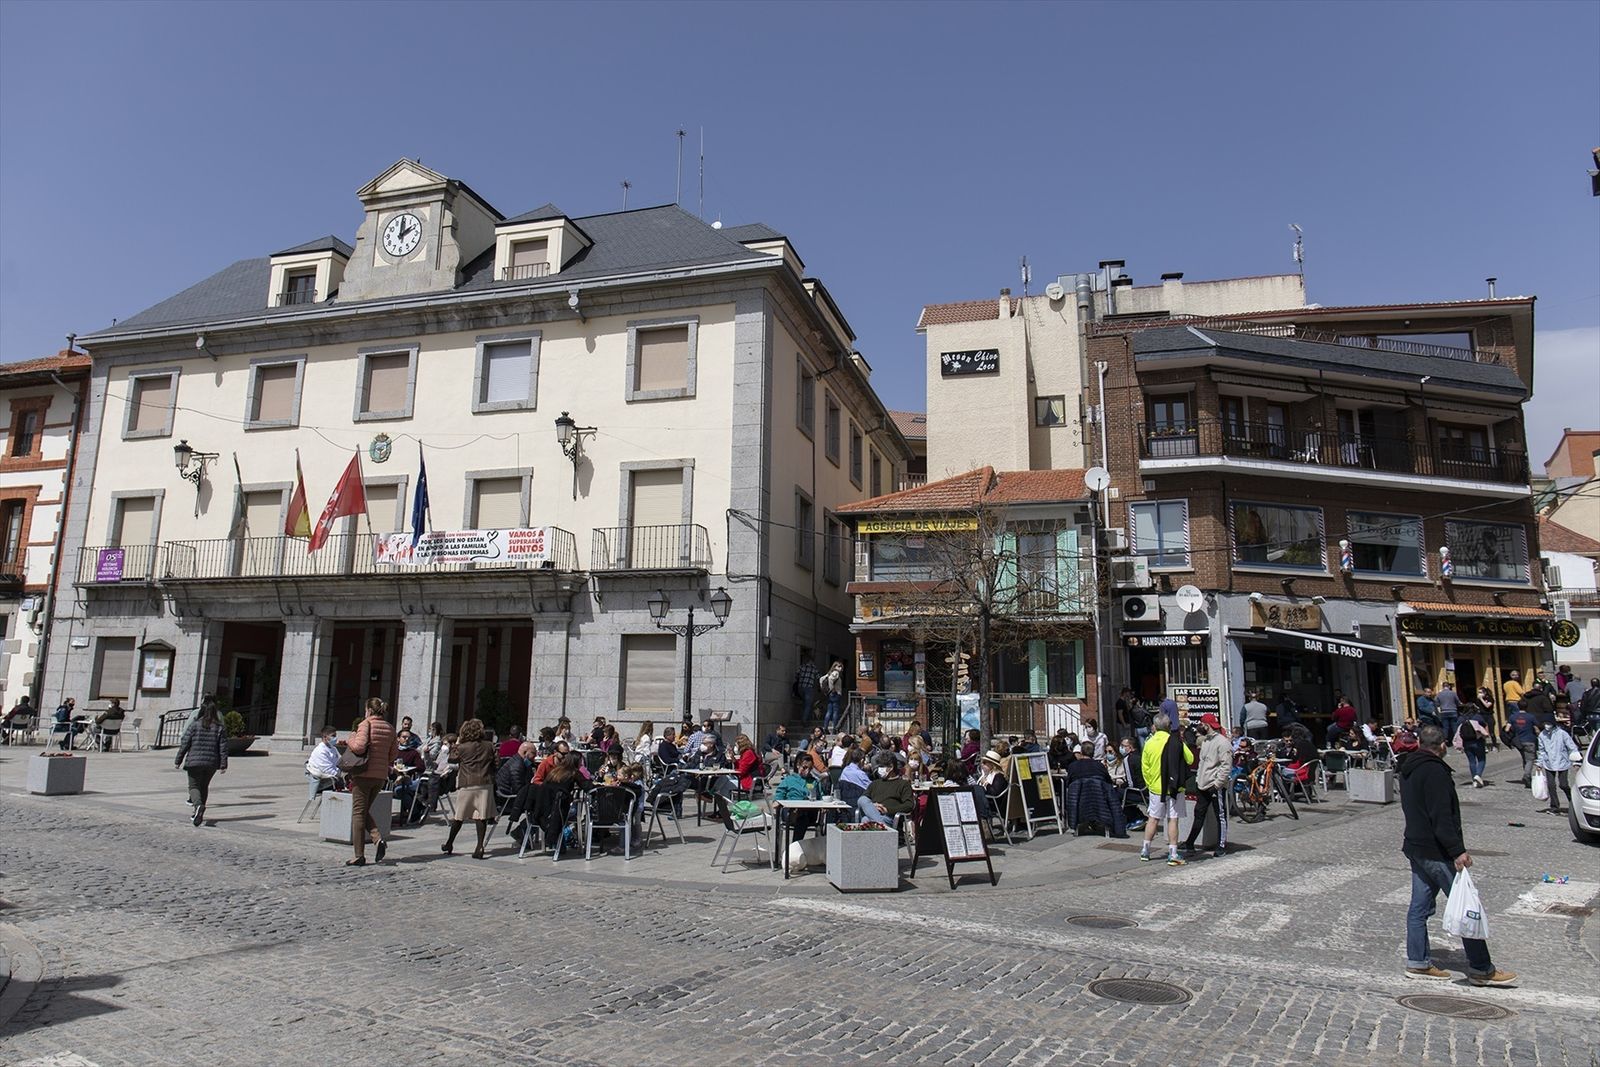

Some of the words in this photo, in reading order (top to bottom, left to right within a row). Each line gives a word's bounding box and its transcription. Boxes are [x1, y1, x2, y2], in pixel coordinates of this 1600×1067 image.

[866, 521, 912, 531] AGENCIA
[915, 520, 929, 530] DE
[932, 519, 970, 529] VIAJES
[509, 530, 537, 538] VAMOS
[508, 544, 544, 553] JUNTOS
[1401, 618, 1424, 630] Café
[1437, 620, 1469, 632] Mesón
[1142, 636, 1187, 646] HAMBURGUESAS
[1304, 639, 1323, 652] BAR
[1327, 643, 1339, 654] EL
[1340, 645, 1363, 659] PASO
